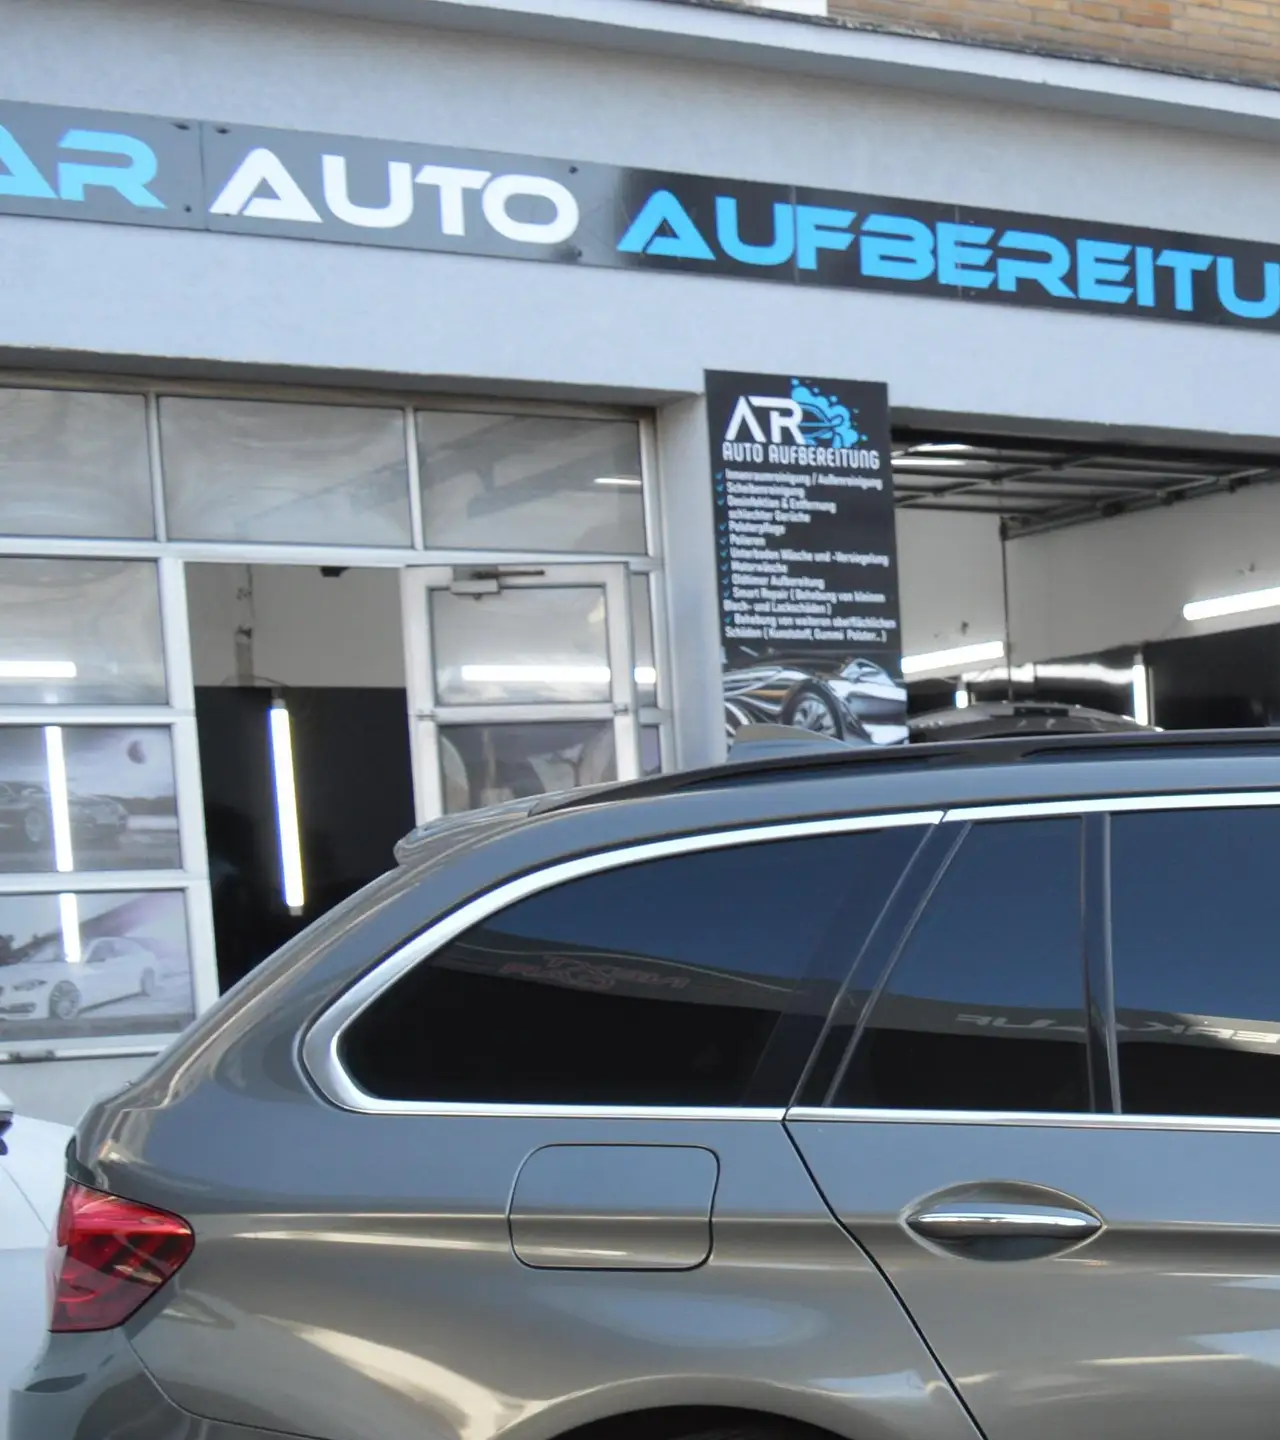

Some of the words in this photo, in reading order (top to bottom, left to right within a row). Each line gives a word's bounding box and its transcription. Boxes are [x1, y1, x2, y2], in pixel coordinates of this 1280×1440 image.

[209, 147, 580, 244] AUTO
[724, 395, 807, 445] AR
[722, 441, 764, 463] AUTO
[768, 444, 881, 470] AUFBEREITUNG
